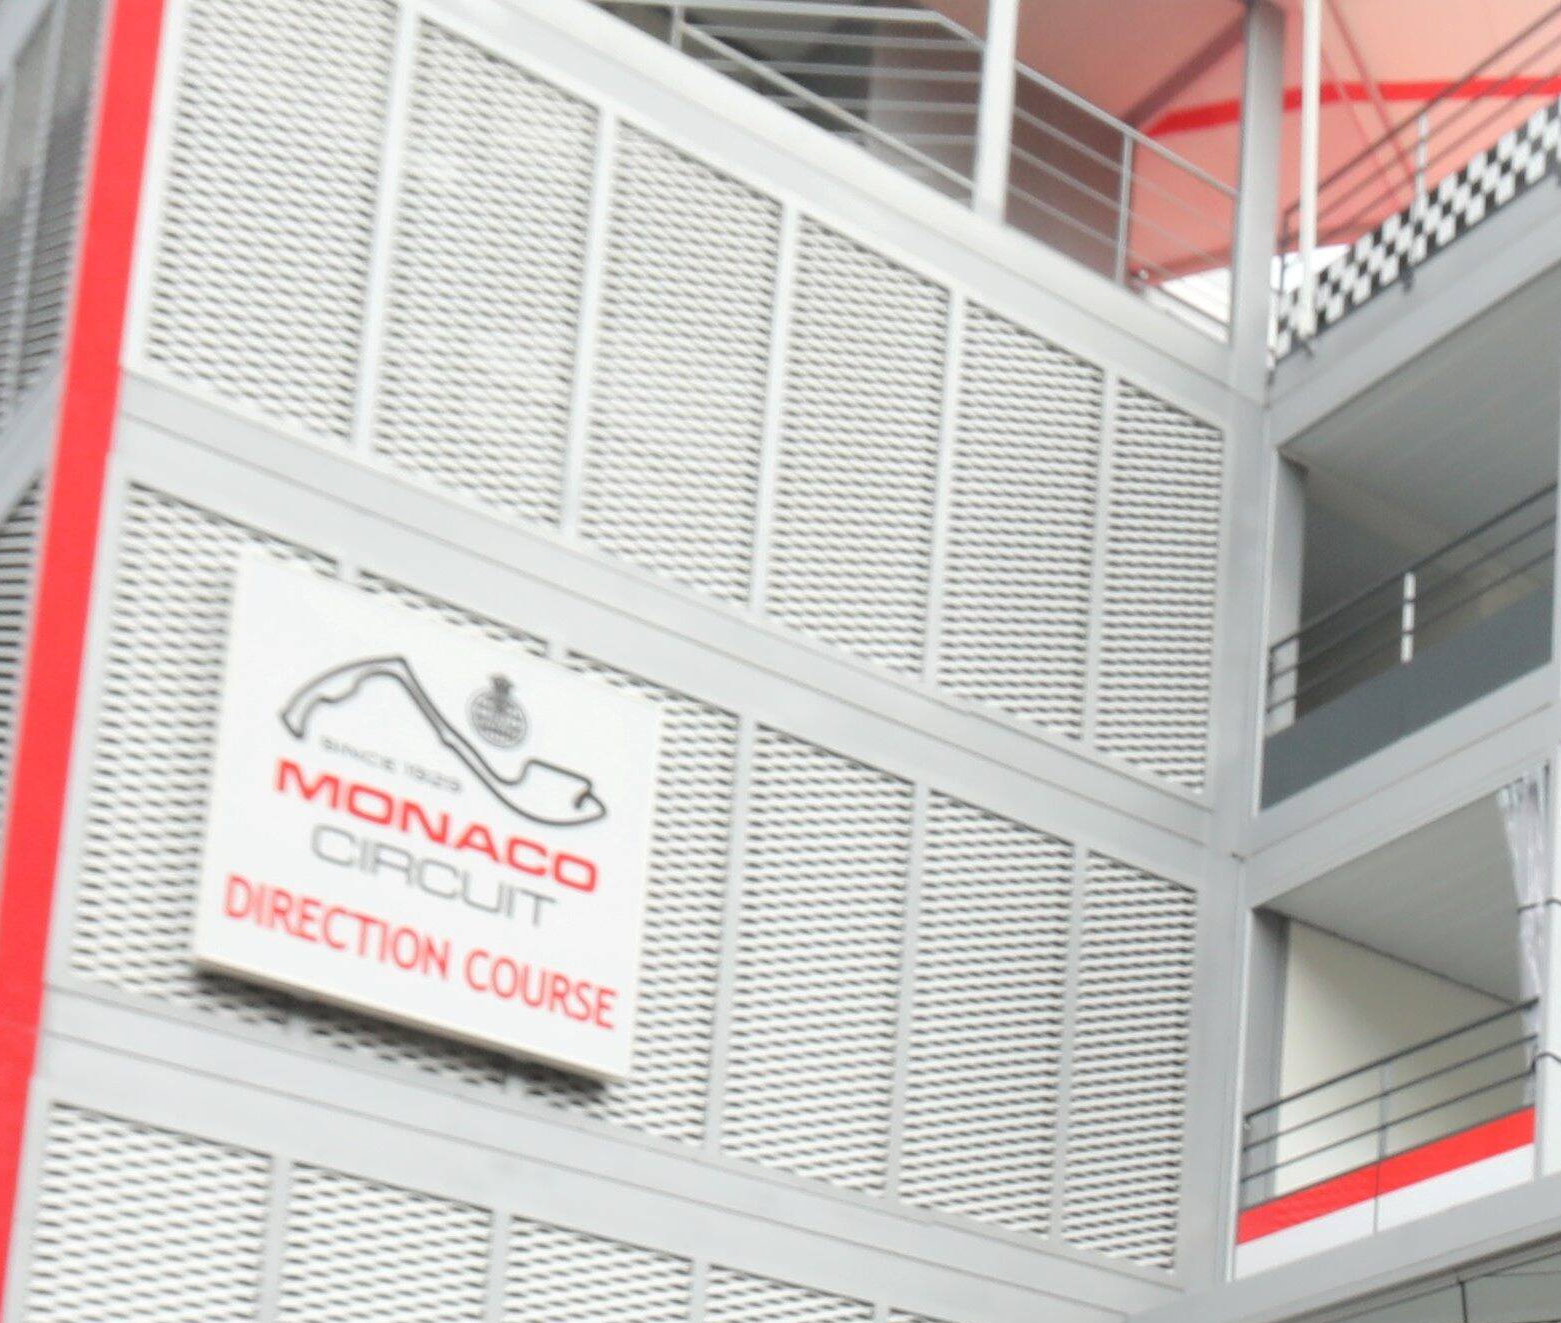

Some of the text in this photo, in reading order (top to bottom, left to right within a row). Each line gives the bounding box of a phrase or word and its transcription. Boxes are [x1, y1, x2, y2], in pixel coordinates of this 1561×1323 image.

[274, 757, 599, 893] MONACO
[312, 823, 557, 927] CIRCUIT
[223, 873, 618, 1031] DIRECTION COURSE
